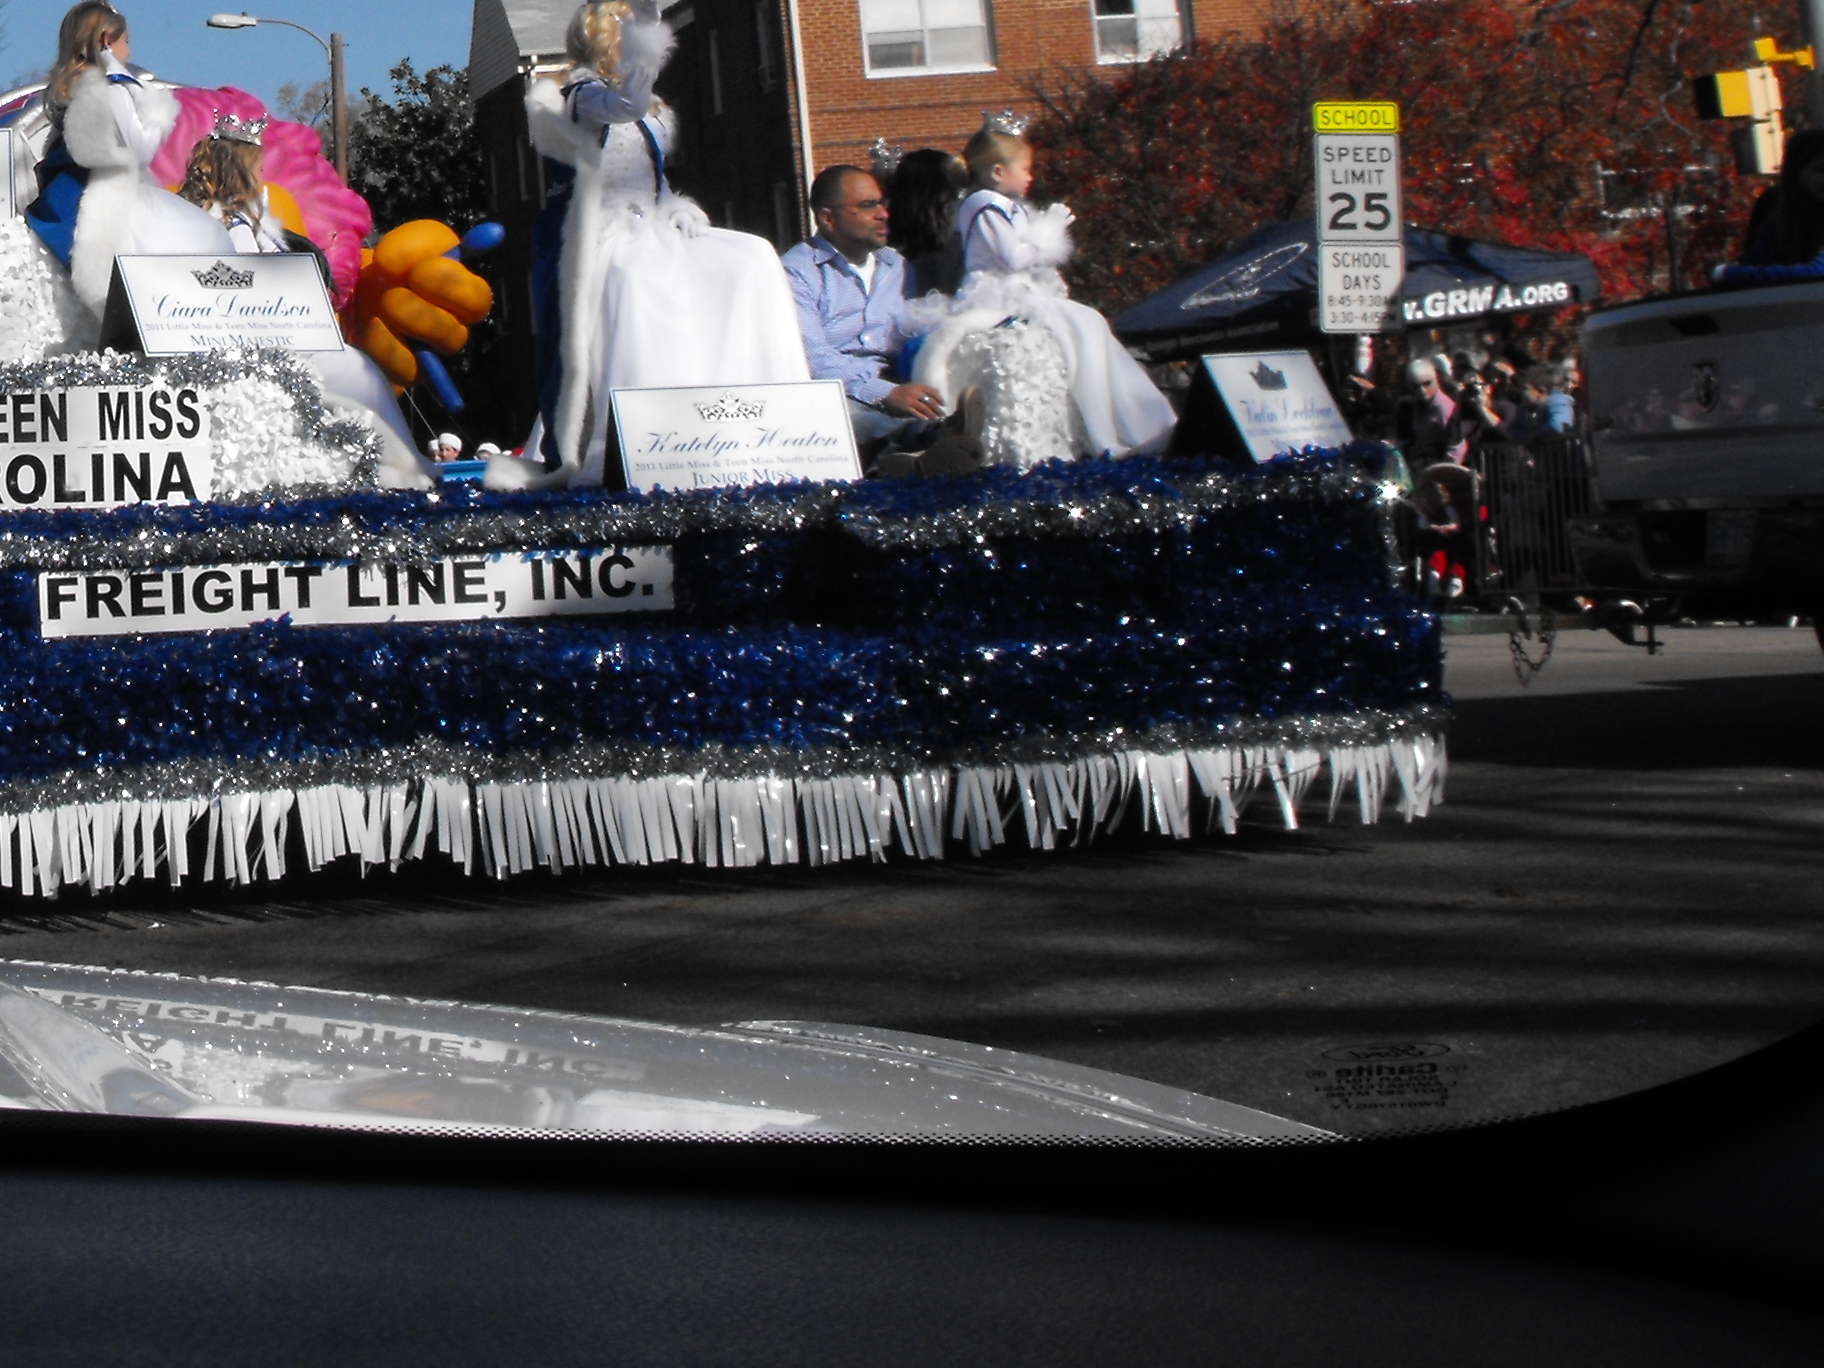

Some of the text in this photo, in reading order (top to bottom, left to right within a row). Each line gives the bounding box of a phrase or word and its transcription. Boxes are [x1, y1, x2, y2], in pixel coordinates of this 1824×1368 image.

[1321, 109, 1392, 126] SCHOOL
[1323, 146, 1392, 163] SPEED
[1331, 169, 1384, 185] LIMIT
[1328, 192, 1392, 231] 25
[1332, 252, 1391, 268] SCHOOL
[1342, 274, 1381, 290] DAYS
[152, 294, 311, 317] Ciara Davidson
[167, 322, 188, 331] Little
[192, 322, 213, 330] Miss
[225, 322, 245, 330] Teen
[248, 322, 268, 330] Miss
[270, 322, 294, 330] North
[297, 321, 332, 329] Carolina
[190, 335, 294, 347] MINI MAJESTIC
[98, 390, 201, 441] MISS
[638, 432, 739, 457] Katelyn
[635, 463, 655, 471] 2011
[659, 461, 684, 470] Little
[687, 460, 711, 469] Miss
[725, 458, 748, 467] Teen
[751, 457, 774, 466] Miss
[777, 455, 805, 464] North
[807, 454, 848, 463] Carolina
[691, 468, 794, 487] JUNIOR MISS
[47, 553, 654, 620] FREIGHT LINE, INC.
